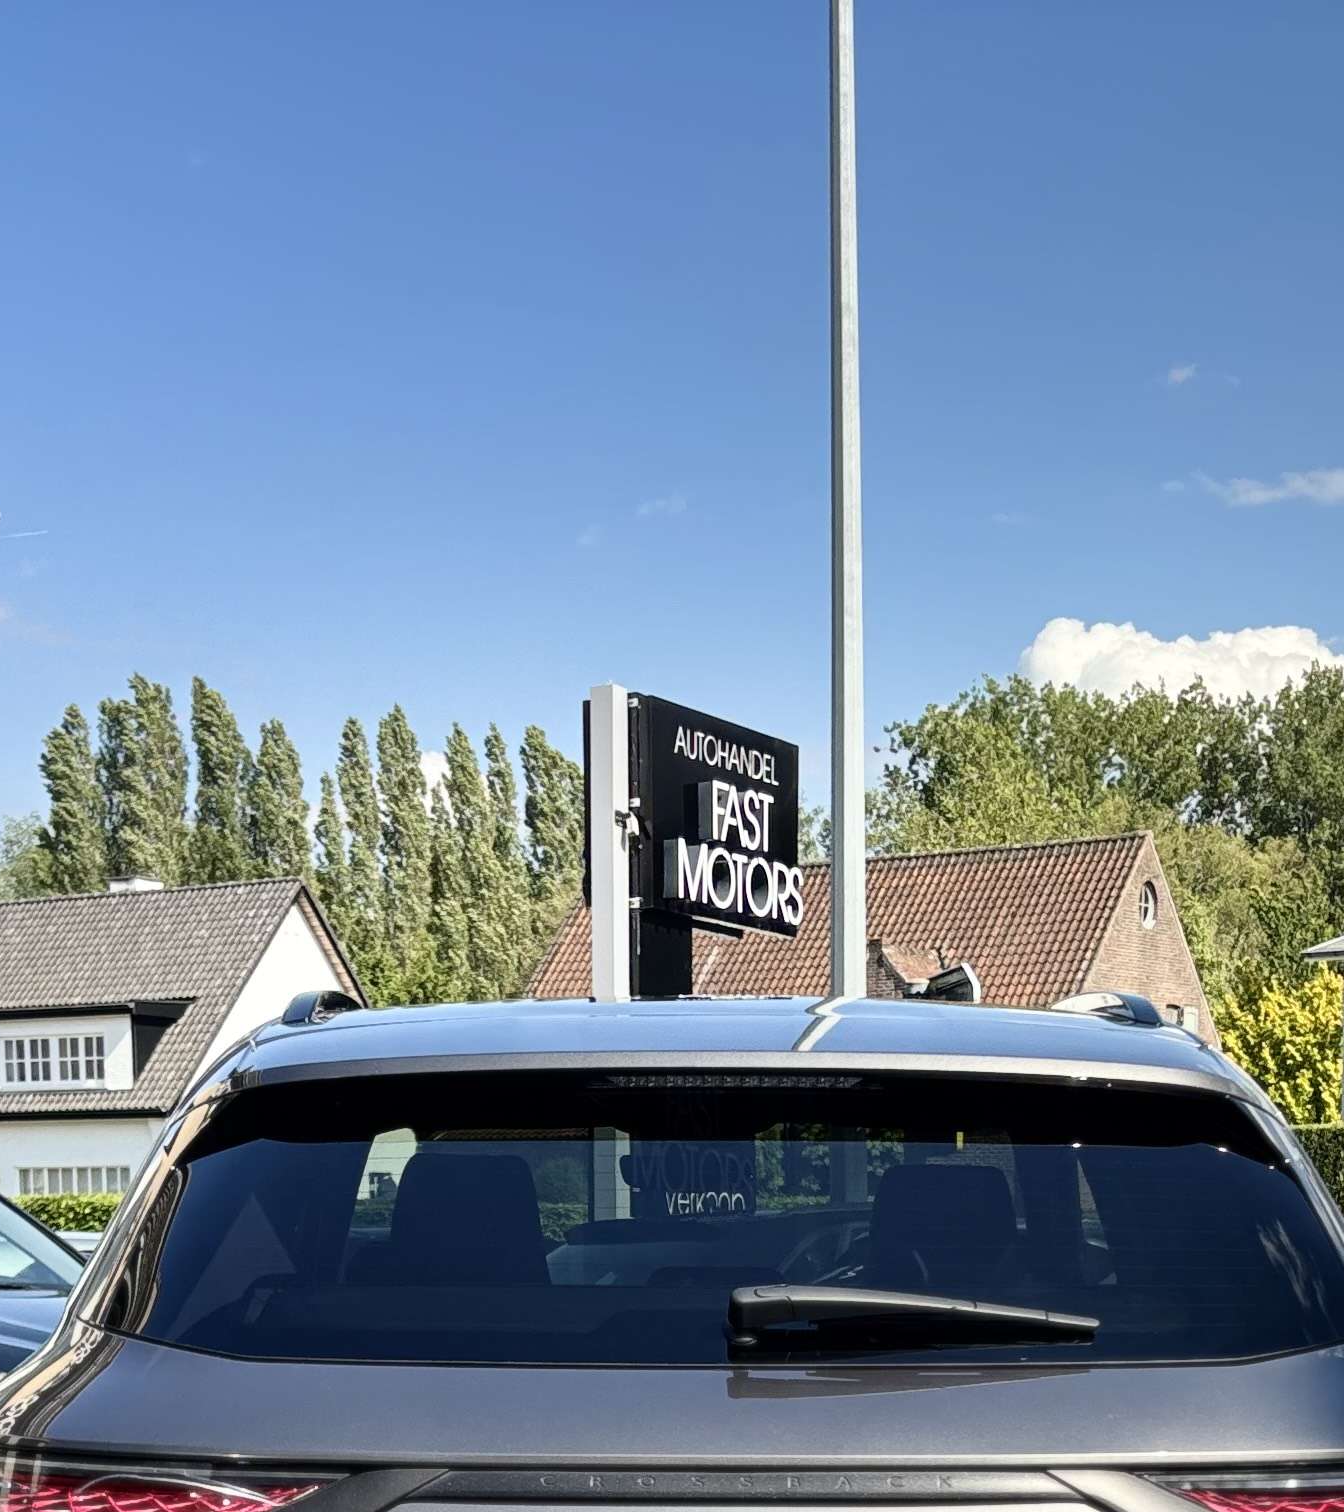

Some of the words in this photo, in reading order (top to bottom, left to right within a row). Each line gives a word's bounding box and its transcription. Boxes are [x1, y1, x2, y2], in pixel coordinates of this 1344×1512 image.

[674, 726, 780, 786] AUTOHANDEL
[711, 779, 774, 852] FAST
[677, 837, 804, 926] MOTORS
